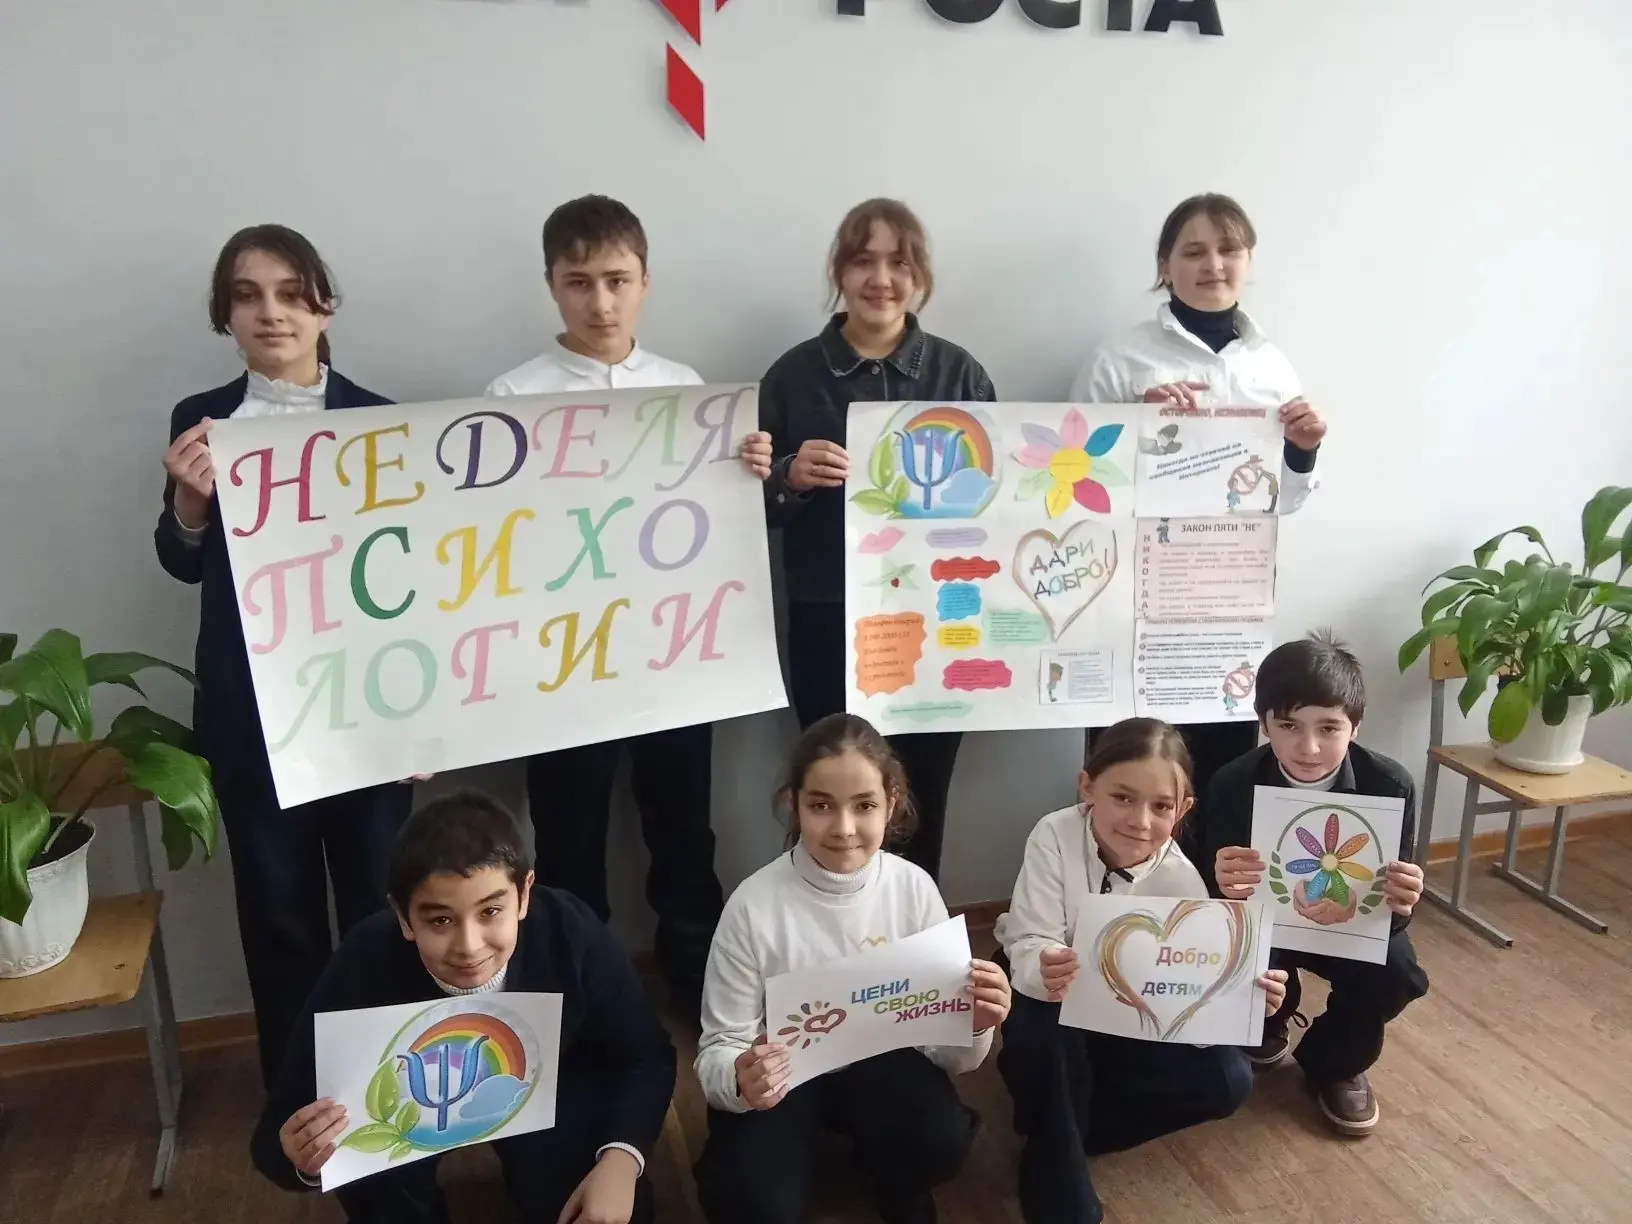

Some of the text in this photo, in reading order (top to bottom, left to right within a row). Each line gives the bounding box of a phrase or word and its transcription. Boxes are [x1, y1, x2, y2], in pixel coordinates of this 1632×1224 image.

[1180, 522, 1262, 533] ЗАКОН ПЯТИ "НЕ"
[1030, 538, 1095, 575] ДАРИ
[242, 497, 710, 656] ПСИХО
[1033, 548, 1111, 600] ДОБРО!
[270, 580, 746, 755] ЛОГИИ
[1155, 945, 1221, 968] Добро
[851, 978, 910, 1004] ЦЕНИ
[873, 988, 940, 1014] СВОЮ
[1141, 981, 1203, 996] детям
[895, 998, 972, 1024] ЖИЗНЬ
